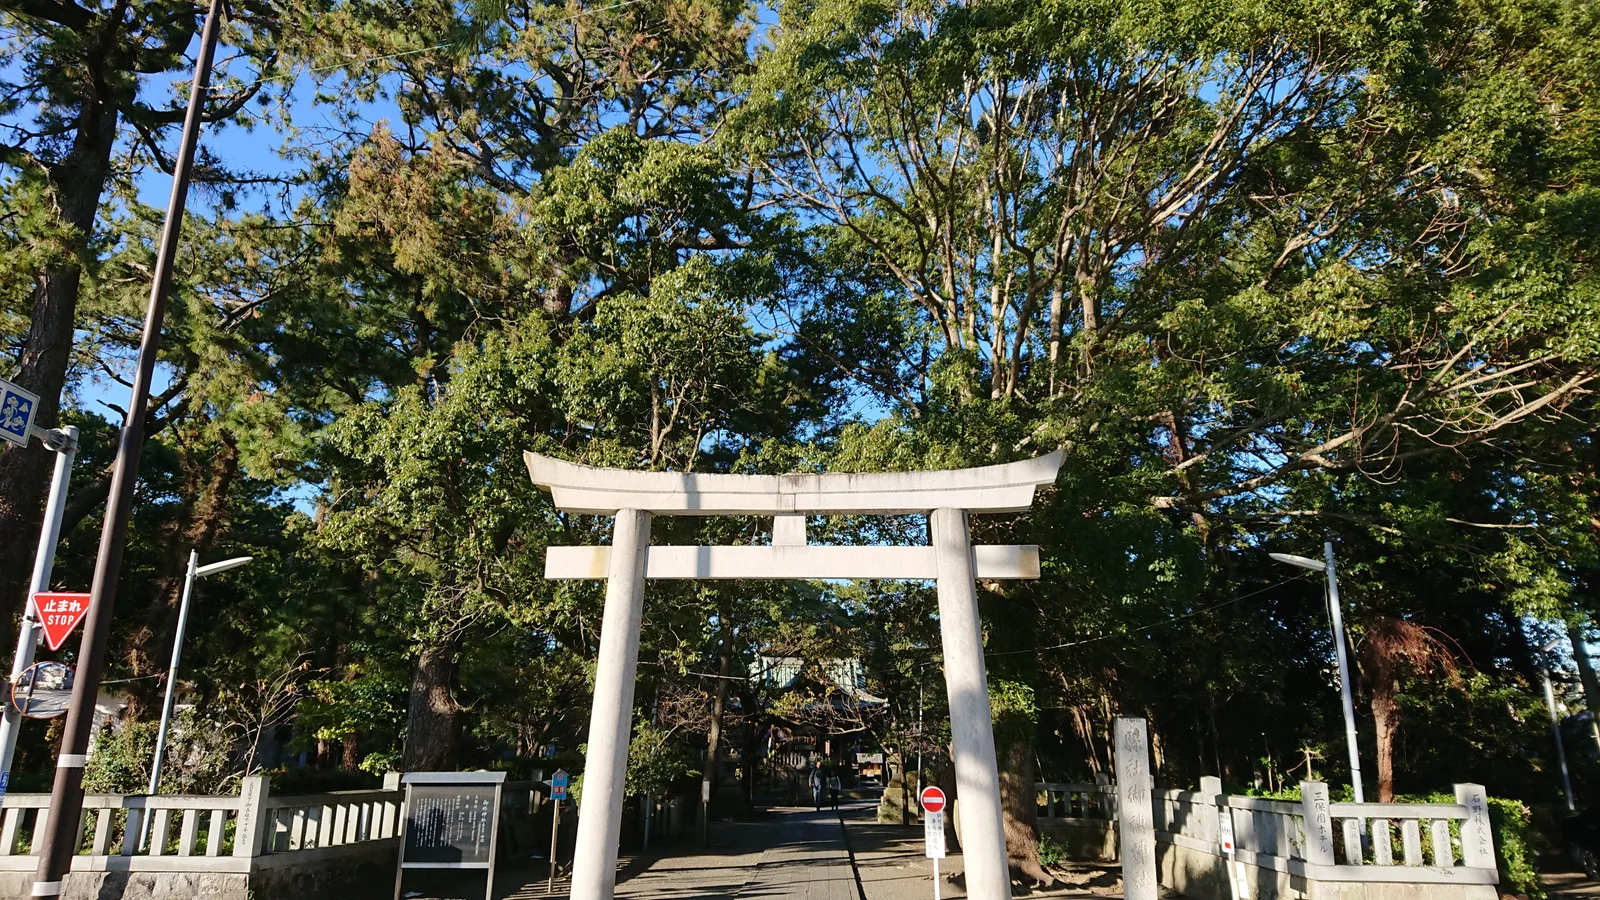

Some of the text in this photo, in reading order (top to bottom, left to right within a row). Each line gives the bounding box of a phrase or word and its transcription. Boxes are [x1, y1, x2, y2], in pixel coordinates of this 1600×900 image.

[43, 600, 82, 613] 止まれ
[47, 614, 74, 626] STOP
